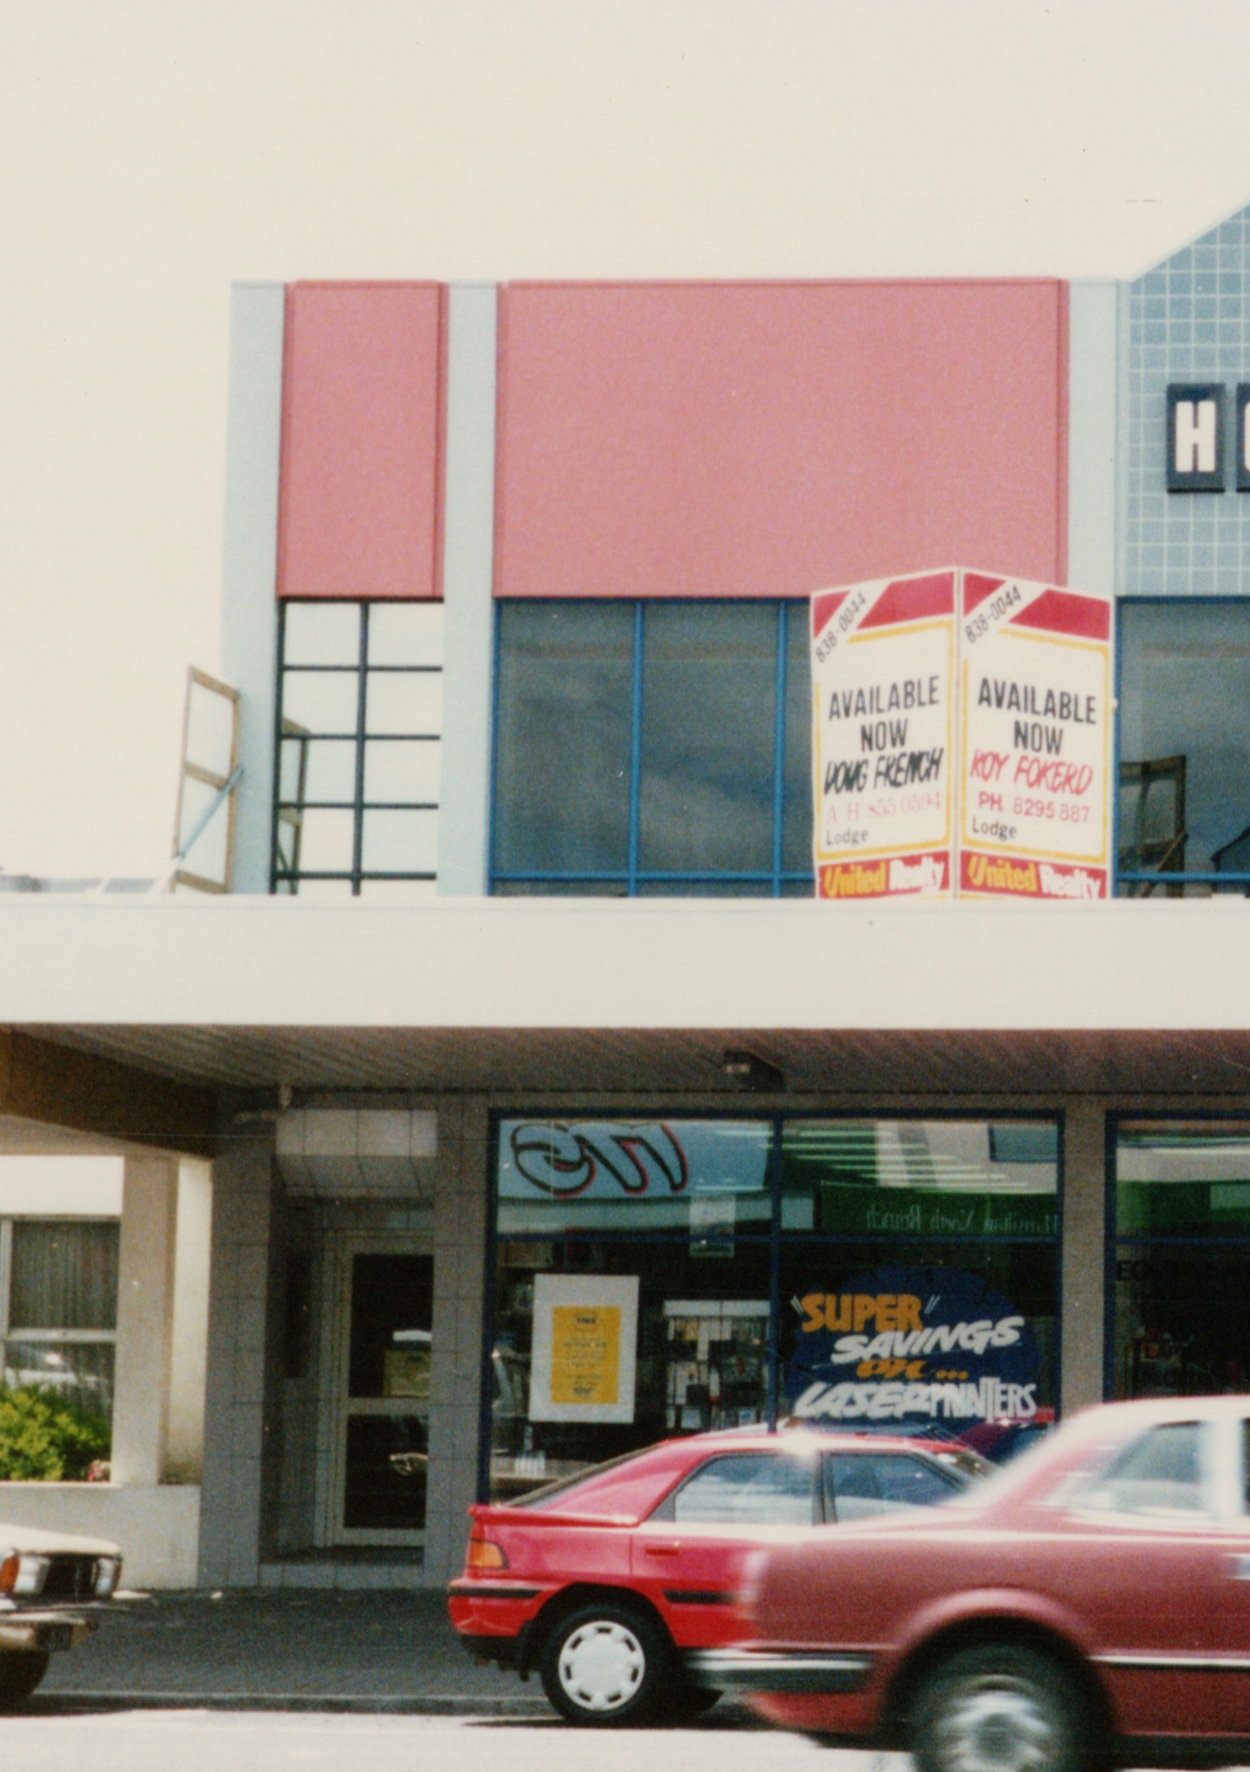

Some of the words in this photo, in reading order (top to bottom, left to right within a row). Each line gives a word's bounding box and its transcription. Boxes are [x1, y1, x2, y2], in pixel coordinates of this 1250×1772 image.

[814, 590, 867, 664] 838-0044
[964, 584, 1022, 645] 838-0044
[828, 676, 939, 721] AVAILABLE
[978, 677, 1097, 725] AVAILABLE
[861, 719, 908, 752] NOW
[1014, 721, 1064, 756] NOW
[824, 759, 870, 796] DOUG
[874, 748, 945, 790] FRENCH
[970, 749, 1010, 782] ROY
[826, 829, 869, 847] Lodge
[972, 815, 1018, 841] Lodge
[823, 860, 887, 899] United
[967, 854, 1038, 893] United
[1038, 862, 1102, 899] Realty
[830, 1315, 1026, 1364] SAVINGS
